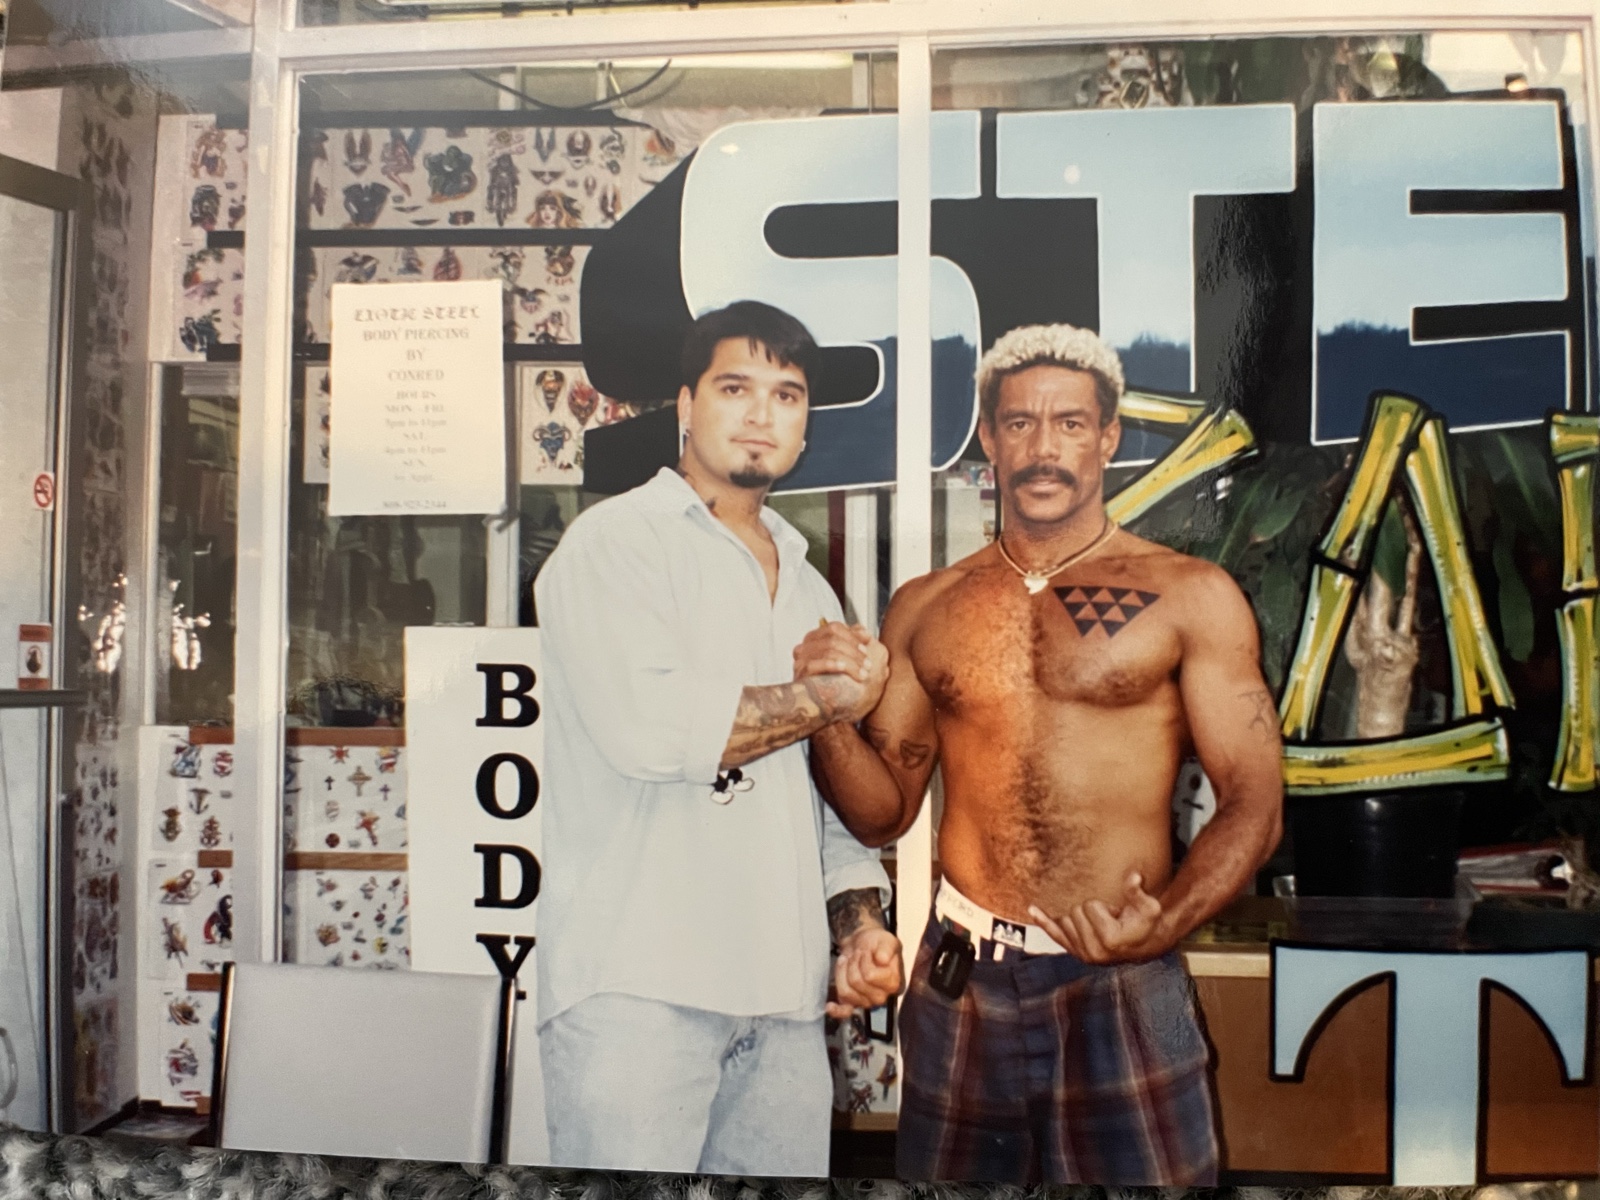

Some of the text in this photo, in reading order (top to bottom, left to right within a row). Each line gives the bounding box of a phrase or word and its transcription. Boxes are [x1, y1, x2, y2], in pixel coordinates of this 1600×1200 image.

[363, 327, 470, 341] BODY PIERCING
[406, 348, 426, 361] BY
[680, 100, 1598, 494] STE
[474, 663, 541, 1000] BODY
